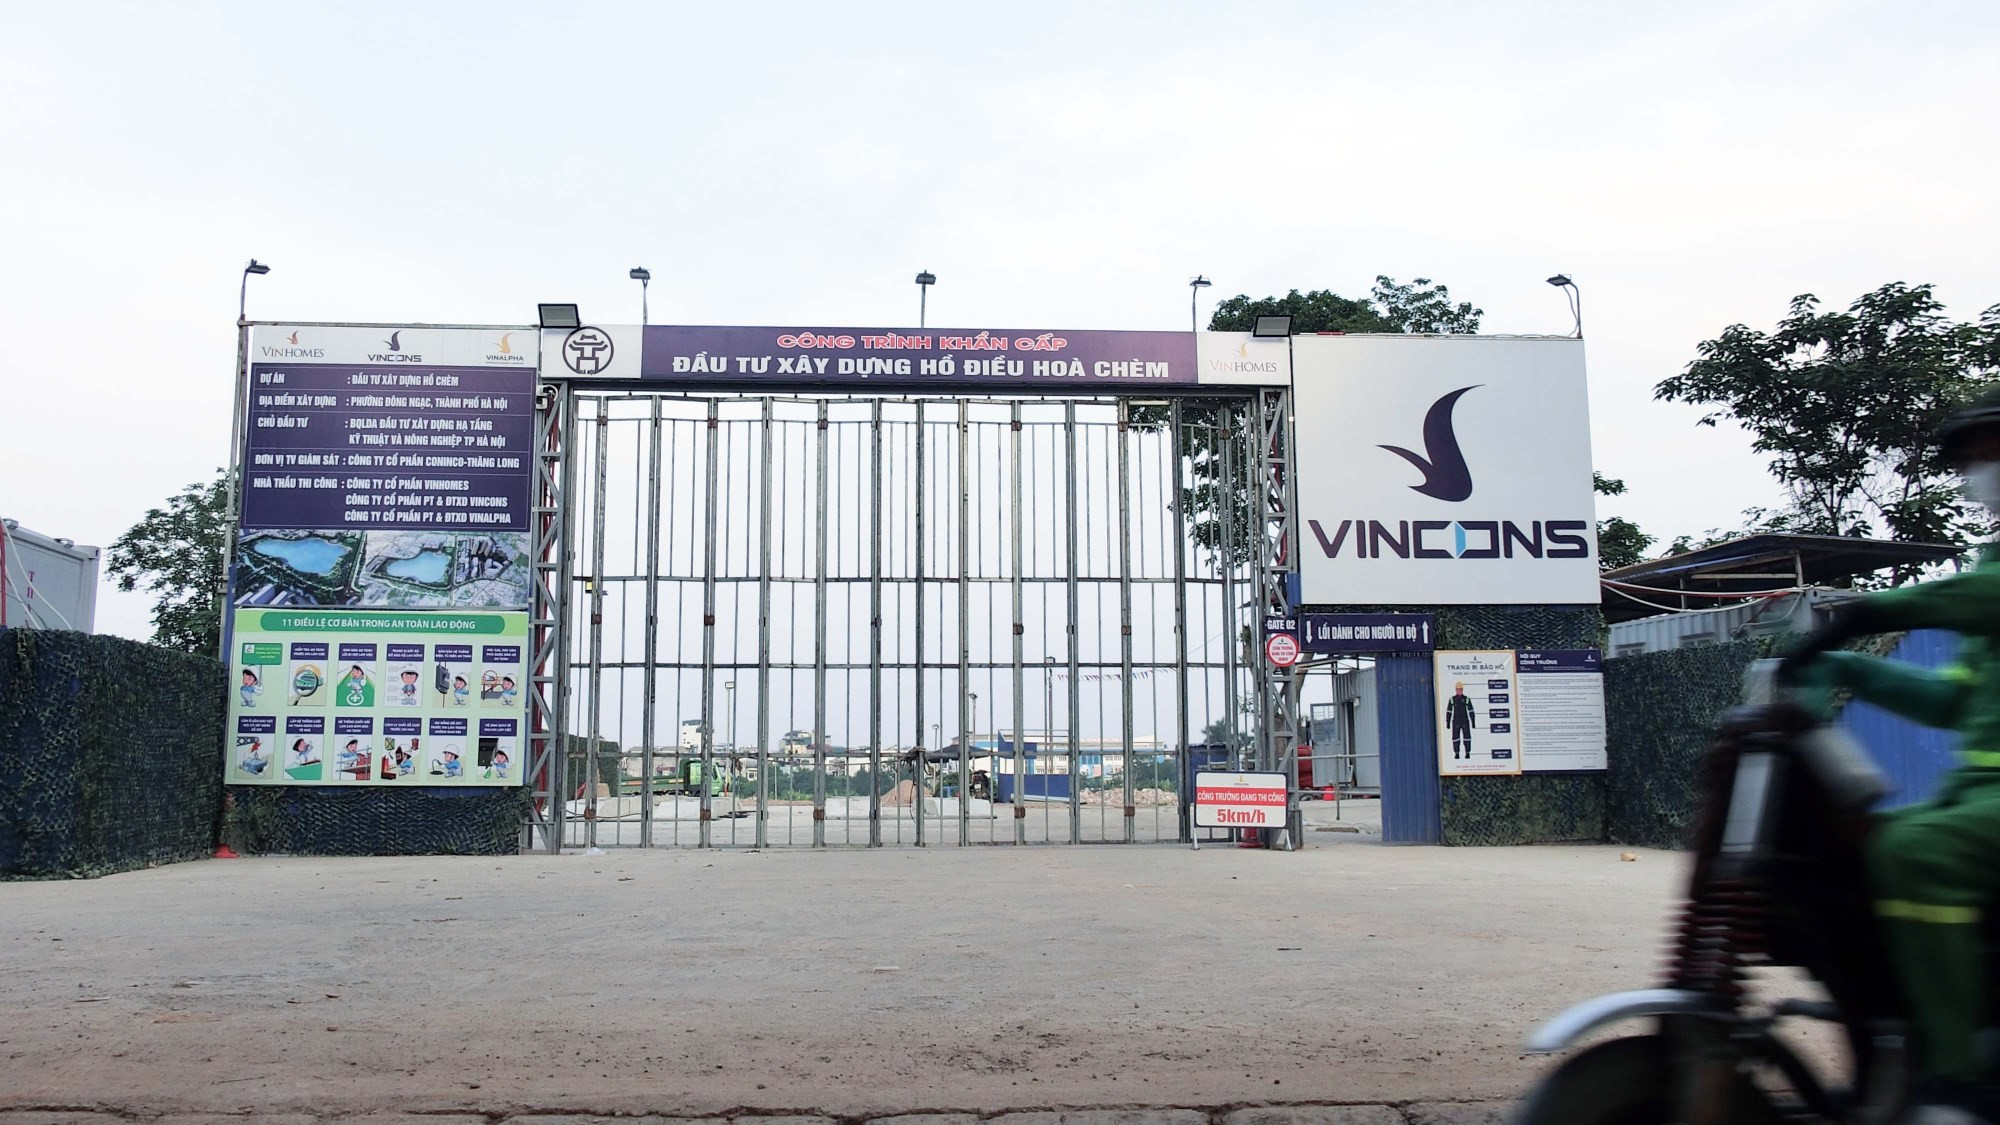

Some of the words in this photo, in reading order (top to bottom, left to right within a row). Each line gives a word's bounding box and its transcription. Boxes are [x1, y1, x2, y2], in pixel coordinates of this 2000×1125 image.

[777, 332, 855, 349] CÔNG
[861, 333, 931, 349] TRÌNH
[940, 331, 1007, 350] KHẨN
[1015, 333, 1067, 351] CẤP
[368, 354, 422, 363] VINCONS
[672, 351, 727, 373] ĐẦU
[736, 356, 772, 373] TƯ
[777, 355, 830, 374] XÂY
[838, 357, 911, 378] DỰNG
[920, 354, 955, 375] HỒ
[963, 355, 1024, 376] ĐIỀU
[1032, 358, 1086, 376] HOÀ
[1094, 358, 1169, 377] CHÈM
[260, 372, 272, 385] DỰ
[273, 372, 285, 383] ÁN
[352, 373, 368, 384] ĐẦU
[370, 374, 382, 384] TƯ
[382, 374, 397, 385] XÂY
[399, 376, 421, 388] DỰNG
[423, 373, 434, 386] HỒ
[436, 375, 459, 386] CHÈM
[259, 396, 272, 407] ĐỊA
[274, 392, 295, 406] ĐIỂM
[297, 394, 313, 406] XÂY
[315, 396, 336, 408] DỰNG
[351, 395, 383, 407] PHƯỜNG
[385, 396, 407, 407] ĐÔNG
[409, 397, 433, 410] NGẠC,
[435, 396, 461, 409] THÀNH
[463, 396, 479, 409] PHỐ
[481, 397, 492, 409] HÀ
[494, 397, 507, 411] NỘI
[258, 415, 275, 427] CHỦ
[277, 415, 295, 427] ĐẦU
[297, 417, 309, 427] TƯ
[350, 419, 377, 430] BQLDA
[380, 416, 397, 429] ĐẦU
[399, 418, 411, 429] TƯ
[412, 417, 429, 429] XÂY
[430, 419, 454, 432] DỰNG
[456, 420, 468, 432] HẠ
[470, 418, 492, 431] TẦNG
[349, 433, 361, 445] KỸ
[363, 434, 390, 447] THUẬT
[391, 433, 402, 445] VÀ
[404, 433, 429, 446] NÔNG
[430, 434, 462, 449] NGHIỆP
[464, 436, 475, 446] TP
[477, 435, 488, 447] HÀ
[490, 435, 505, 449] NỘI
[255, 454, 273, 464] ĐƠN
[276, 455, 284, 467] VỊ
[286, 455, 296, 464] TV
[298, 453, 321, 465] GIÁM
[323, 453, 339, 465] SÁT
[348, 455, 372, 466] CÔNG
[374, 456, 384, 466] TY
[386, 453, 398, 466] CỔ
[400, 454, 424, 467] PHẦN
[497, 458, 520, 468] LONG
[254, 476, 272, 488] NHÀ
[274, 475, 296, 488] THẦU
[298, 478, 311, 488] THI
[314, 477, 337, 488] CÔNG
[347, 477, 370, 488] CÔNG
[372, 479, 382, 488] TY
[385, 476, 397, 489] CỔ
[399, 476, 422, 490] PHẦN
[425, 480, 469, 491] VINHOMES
[346, 493, 370, 505] CÔNG
[372, 496, 382, 505] TY
[384, 492, 396, 506] CỔ
[398, 493, 421, 506] PHẦN
[424, 496, 435, 506] PT
[437, 497, 443, 506] &
[446, 497, 468, 507] ĐTXD
[470, 497, 507, 508] VINCONS
[345, 510, 368, 521] CÔNG
[371, 512, 381, 521] TY
[383, 508, 395, 522] CỔ
[397, 510, 421, 522] PHẦN
[423, 512, 434, 522] PT
[436, 513, 442, 522] &
[445, 513, 467, 523] ĐTXD
[469, 513, 511, 524] VINALPHA
[1308, 520, 1588, 559] VINCONS
[294, 617, 315, 627] ĐIỀU
[316, 618, 326, 629] LỆ
[328, 619, 340, 627] CƠ
[342, 617, 359, 627] BẢN
[361, 620, 390, 628] TRONG
[392, 620, 404, 628] AN
[406, 619, 429, 628] TOÀN
[431, 621, 447, 629] LAO
[450, 620, 476, 631] ĐỘNG
[1268, 620, 1285, 630] GATE
[1286, 620, 1295, 630] 02
[1318, 622, 1330, 640] LỐI
[1332, 624, 1353, 640] DÀNH
[1354, 626, 1370, 640] CHO
[1372, 623, 1395, 640] NGƯỜI
[1396, 626, 1405, 640] ĐI
[1406, 624, 1417, 642] BỘ
[1198, 790, 1214, 801] CÔNG
[1216, 790, 1240, 801] TRƯỜNG
[1241, 793, 1257, 801] ĐANG
[1258, 794, 1267, 802] THI
[1268, 792, 1285, 802] CÔNG
[1217, 809, 1266, 824] 5km/h
